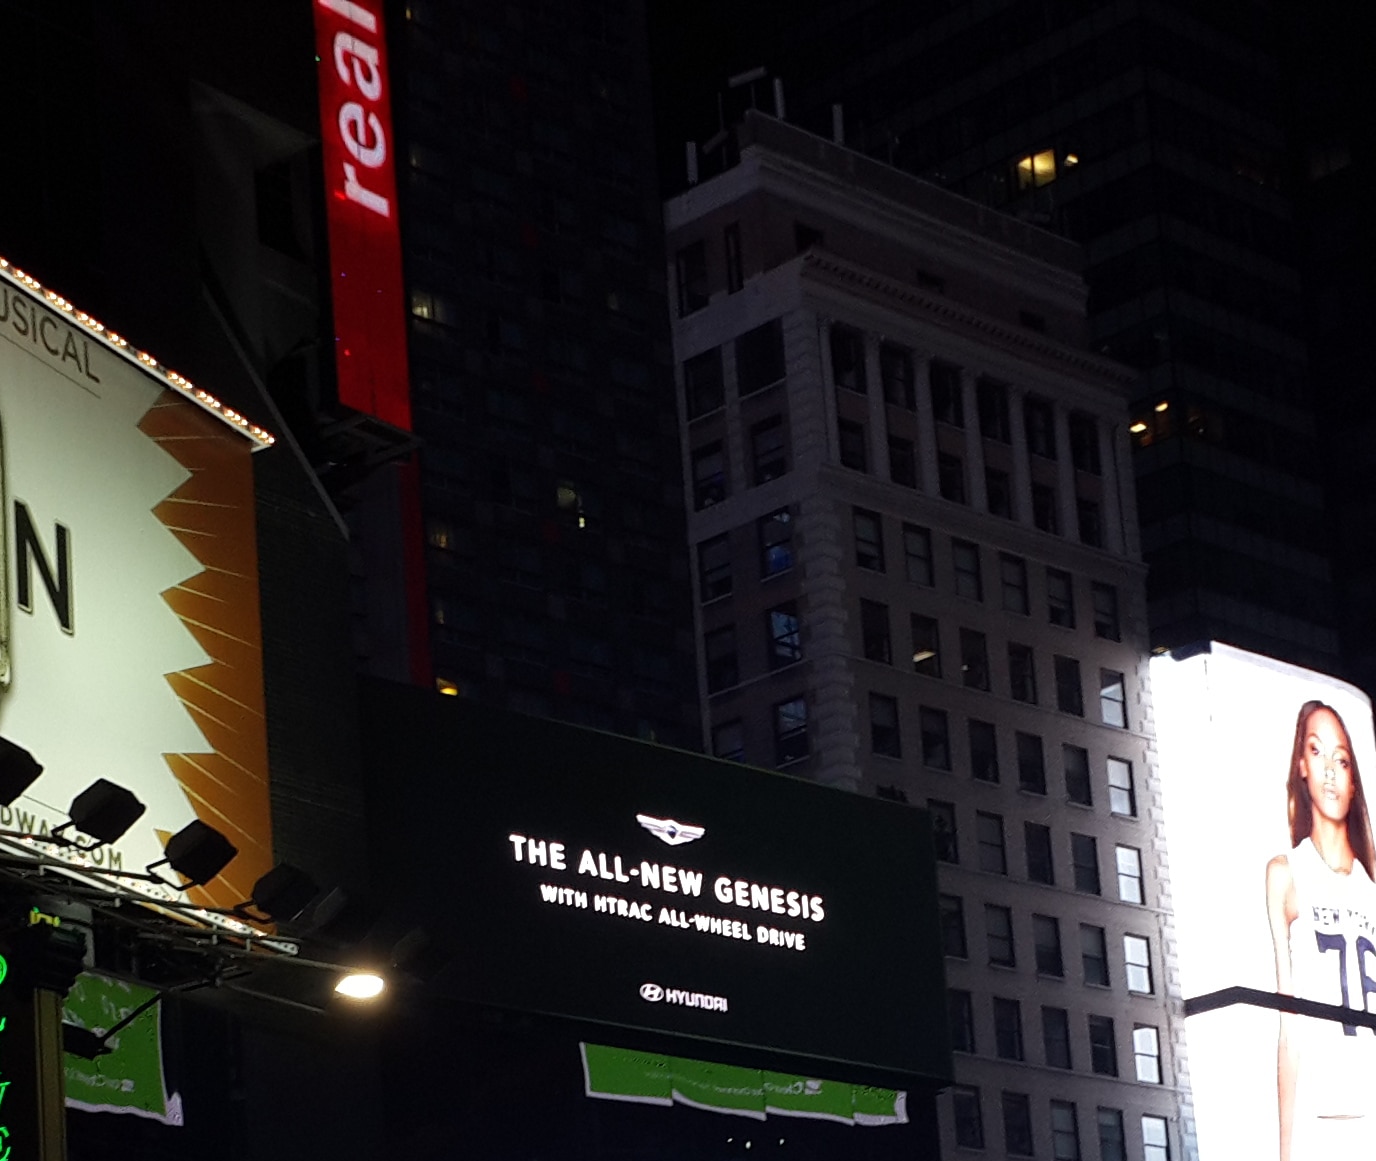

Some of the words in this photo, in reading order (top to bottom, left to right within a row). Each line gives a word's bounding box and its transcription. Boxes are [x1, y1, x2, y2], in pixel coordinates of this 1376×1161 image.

[508, 832, 567, 872] THE
[577, 849, 704, 898] ALL-NEW
[713, 875, 827, 924] GENESIS
[538, 883, 589, 909] WITH
[593, 894, 654, 922] HTRAC
[657, 907, 753, 942] ALL-WHEEL
[756, 925, 807, 952] DRIVE
[665, 988, 729, 1014] HYUNDAI
